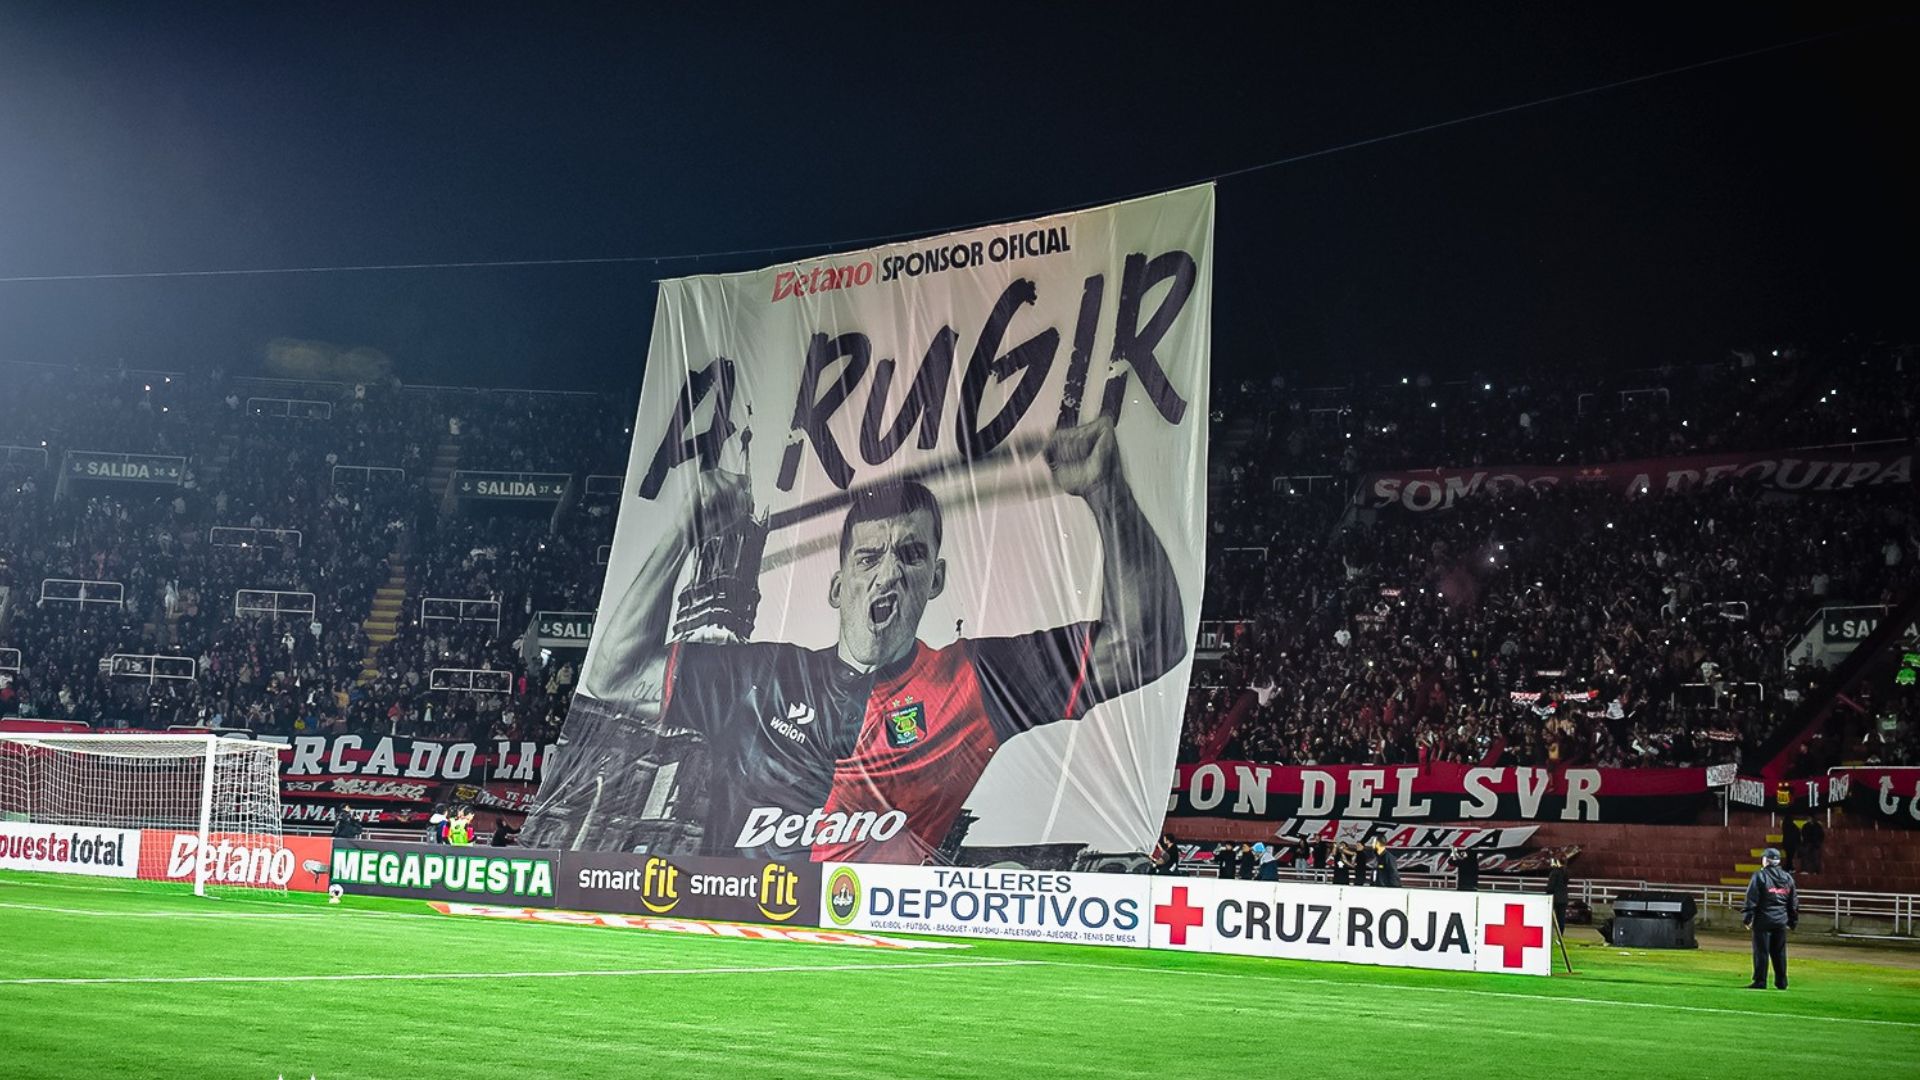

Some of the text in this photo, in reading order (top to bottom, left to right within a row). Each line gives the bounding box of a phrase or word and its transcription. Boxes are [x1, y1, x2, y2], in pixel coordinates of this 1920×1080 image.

[772, 226, 1071, 303] Betano SPONSOR OFICIAL
[638, 357, 736, 501] A
[87, 461, 150, 478] SALIDA
[477, 481, 536, 496] SALIDA
[770, 716, 806, 744] walon
[1296, 767, 1432, 818] DEL
[1459, 766, 1602, 821] SVR
[734, 806, 908, 848] Betano
[167, 833, 295, 885] Betano
[332, 848, 553, 897] MEGAPUESTA
[578, 857, 679, 898] smart fit
[690, 862, 798, 906] smart fit
[934, 870, 1072, 894] TALLERES
[869, 887, 1139, 930] DEPORTIVOS
[1216, 899, 1471, 955] CRUZ ROJA
